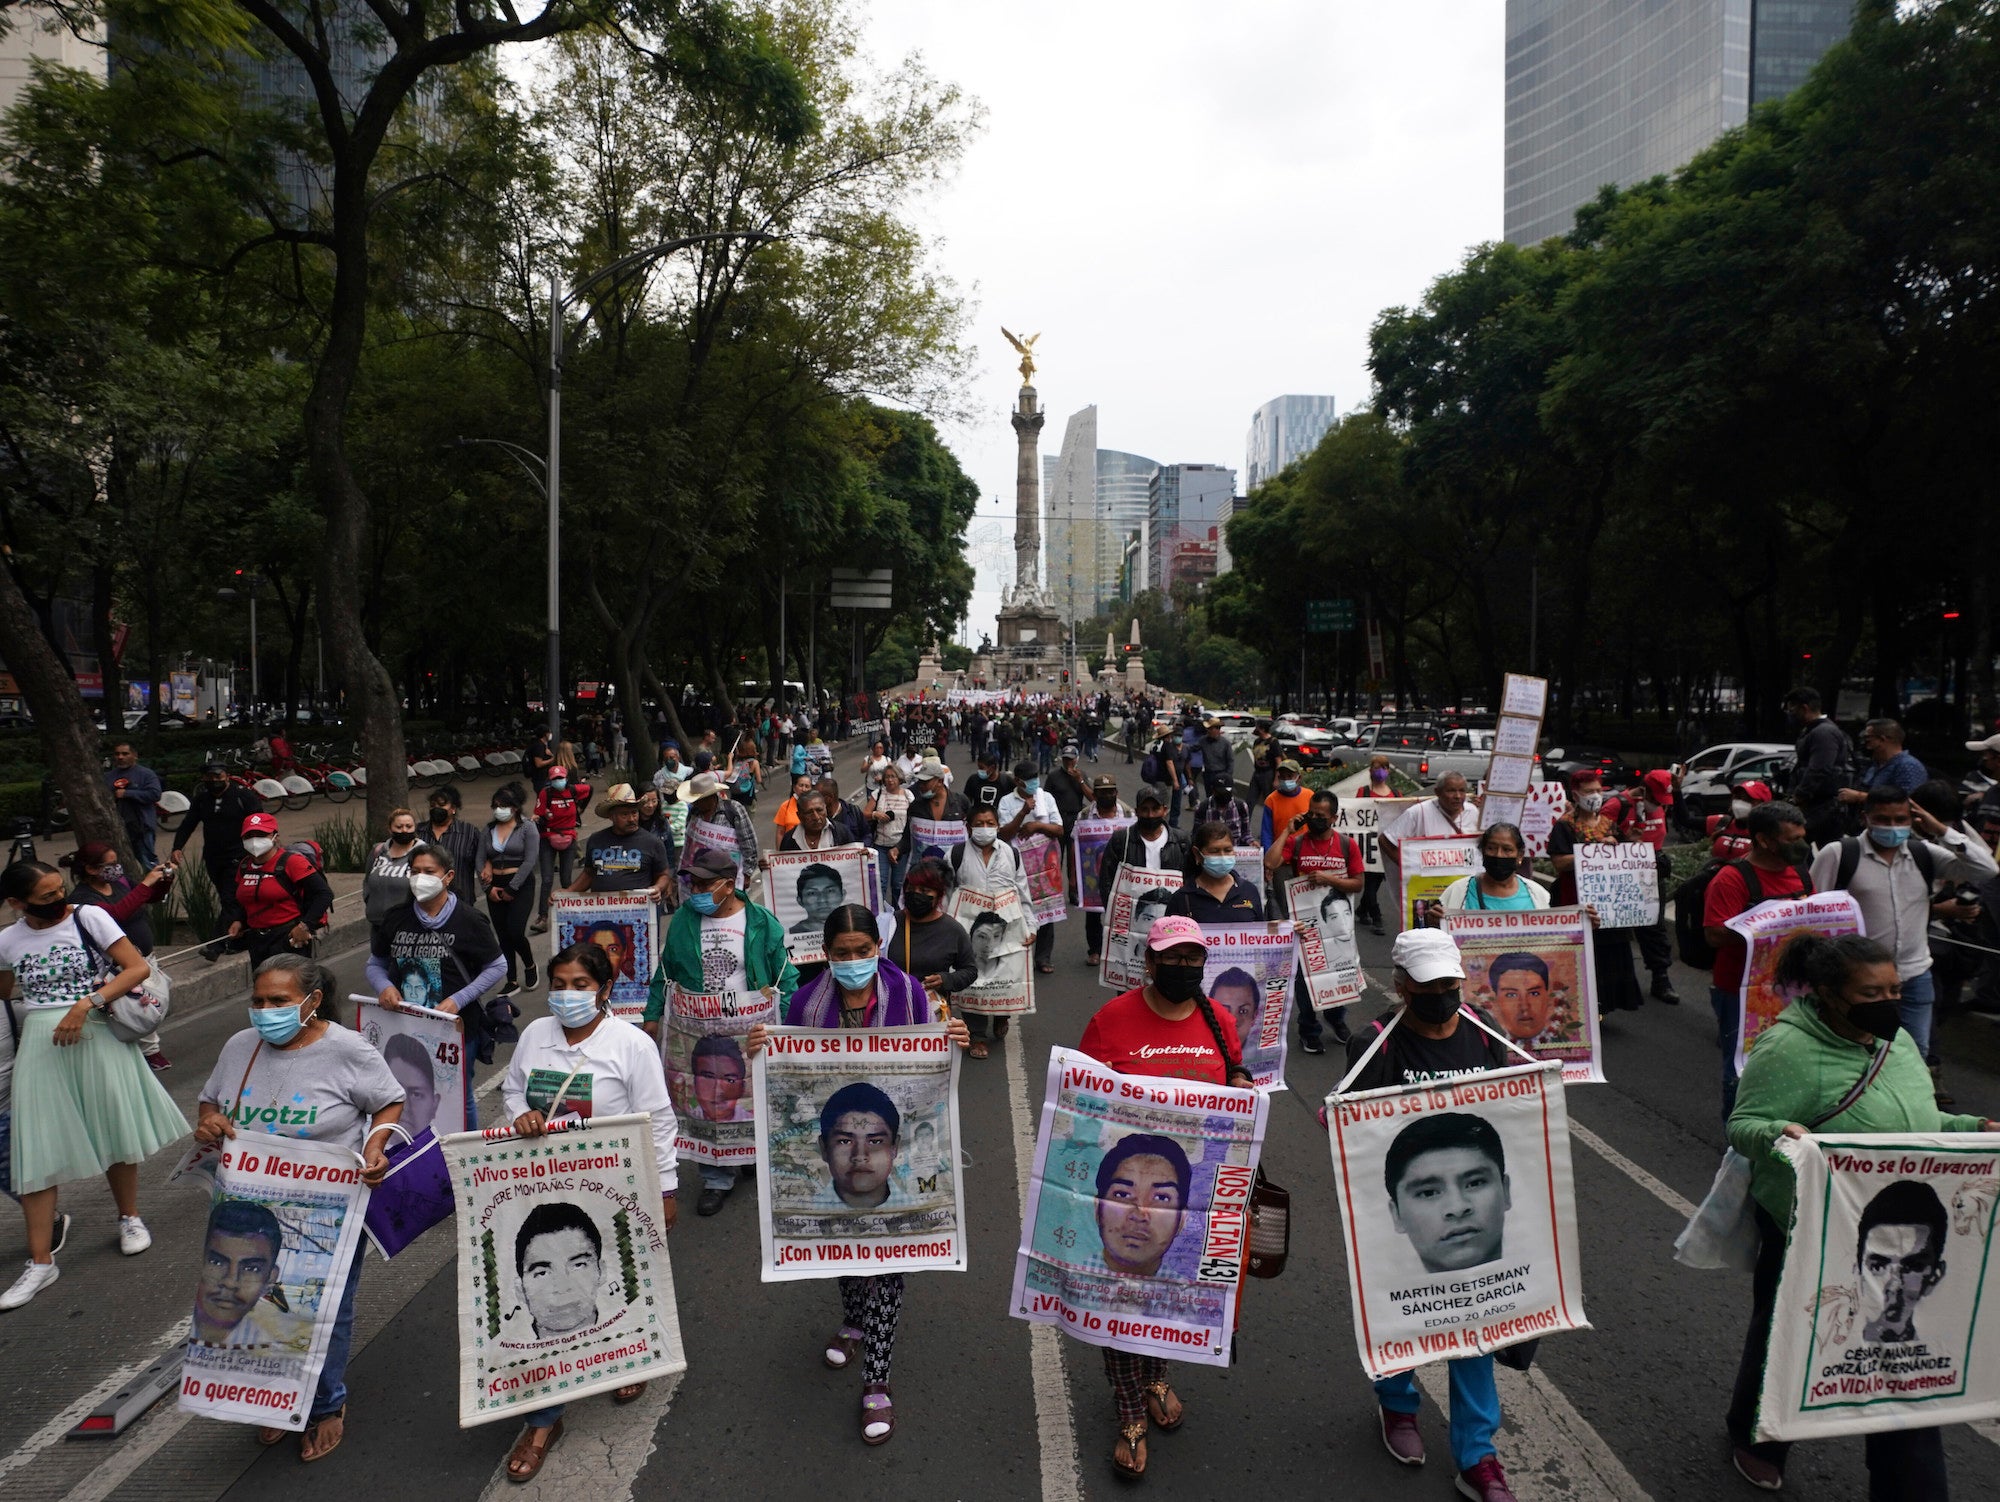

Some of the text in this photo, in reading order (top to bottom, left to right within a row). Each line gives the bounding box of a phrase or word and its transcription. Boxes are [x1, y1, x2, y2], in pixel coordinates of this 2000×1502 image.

[909, 705, 934, 723] 43
[910, 735, 934, 744] SIGUE
[592, 849, 641, 861] POLO
[772, 857, 795, 867] ¡Vivo
[821, 853, 858, 861] llevaron!
[1421, 851, 1436, 866] NOS
[1438, 850, 1464, 864] FALTAN
[1582, 843, 1646, 858] CASTIGO
[1121, 872, 1140, 883] ¡Vivo
[1155, 878, 1161, 886] lo
[1583, 884, 1605, 893] CIEN
[558, 895, 647, 909] ¡Vivo se lo llevaron!
[962, 893, 992, 909] ¡Vivo se
[1450, 913, 1580, 930] ¡Vivo se lo llevaron!
[1743, 911, 1776, 926] ¡Vivo
[1779, 907, 1792, 918] se
[1795, 904, 1804, 915] lo
[1808, 901, 1851, 914] llevaron!
[1206, 932, 1294, 945] se lo llevaron!
[1311, 956, 1326, 972] NOS
[1109, 971, 1123, 981] ¡Con
[962, 996, 1025, 1007] VIDA lo queremos!
[1319, 986, 1352, 1001] ¡Con VIDA
[689, 996, 721, 1018] FALTAN
[722, 991, 738, 1017] 43!
[1263, 991, 1284, 1027] FALTAN
[768, 1035, 949, 1056] ¡Vivo se lo llevaron!
[1261, 1027, 1279, 1048] NOS
[436, 1043, 459, 1065] 43
[1129, 1044, 1214, 1058] Ayotzinapa
[1064, 1068, 1255, 1114] ¡Vivo se lo llevaron!
[1342, 1075, 1536, 1126] ¡Vivo se lo llevaron!
[699, 1142, 755, 1158] lo querem
[238, 1152, 259, 1172] lo
[265, 1156, 361, 1184] llevaron!
[474, 1154, 618, 1187] ¡Vivo se lo llevaron!
[1065, 1160, 1090, 1180] 43
[1829, 1154, 1995, 1175] ¡Vivo se lo llevaron!
[1216, 1165, 1253, 1199] NOS
[480, 1178, 665, 1252] MOVERE MONTAÑAS POR ENCONTRARTE
[778, 1218, 830, 1226] CHRISTIAN
[908, 1211, 951, 1223] GARNICA
[1053, 1225, 1076, 1248] 43
[1204, 1201, 1245, 1259] FALTAN
[781, 1239, 951, 1264] ¡Con VIDA lo queremos!
[1199, 1257, 1239, 1283] 43!
[1034, 1264, 1220, 1307] José Eduardo Bartolo Tlatempa
[1390, 1265, 1531, 1302] MARTÍN GETSEMANY
[1402, 1282, 1525, 1315] SÁNCHEZ GARCÍA
[1033, 1294, 1210, 1347] ¡Vivo lo queremos!
[1424, 1302, 1516, 1327] EDAD 20 AÑOS
[500, 1341, 525, 1349] NUNCA
[526, 1340, 559, 1349] ESPERES
[561, 1335, 577, 1344] QUE
[589, 1309, 626, 1334] OLVIDEMOS
[1378, 1305, 1560, 1364] ¡Con VIDA lo queremos!
[197, 1353, 280, 1368] Abarca Carillo
[1845, 1346, 1879, 1360] CÉSAR
[488, 1339, 647, 1396] ¡Con VIDA lo queremos!
[1879, 1357, 1951, 1373] HERNÁNDEZ
[183, 1377, 298, 1410] lo queremos!
[1810, 1370, 1957, 1402] ¡Con VIDA lo queremos!
